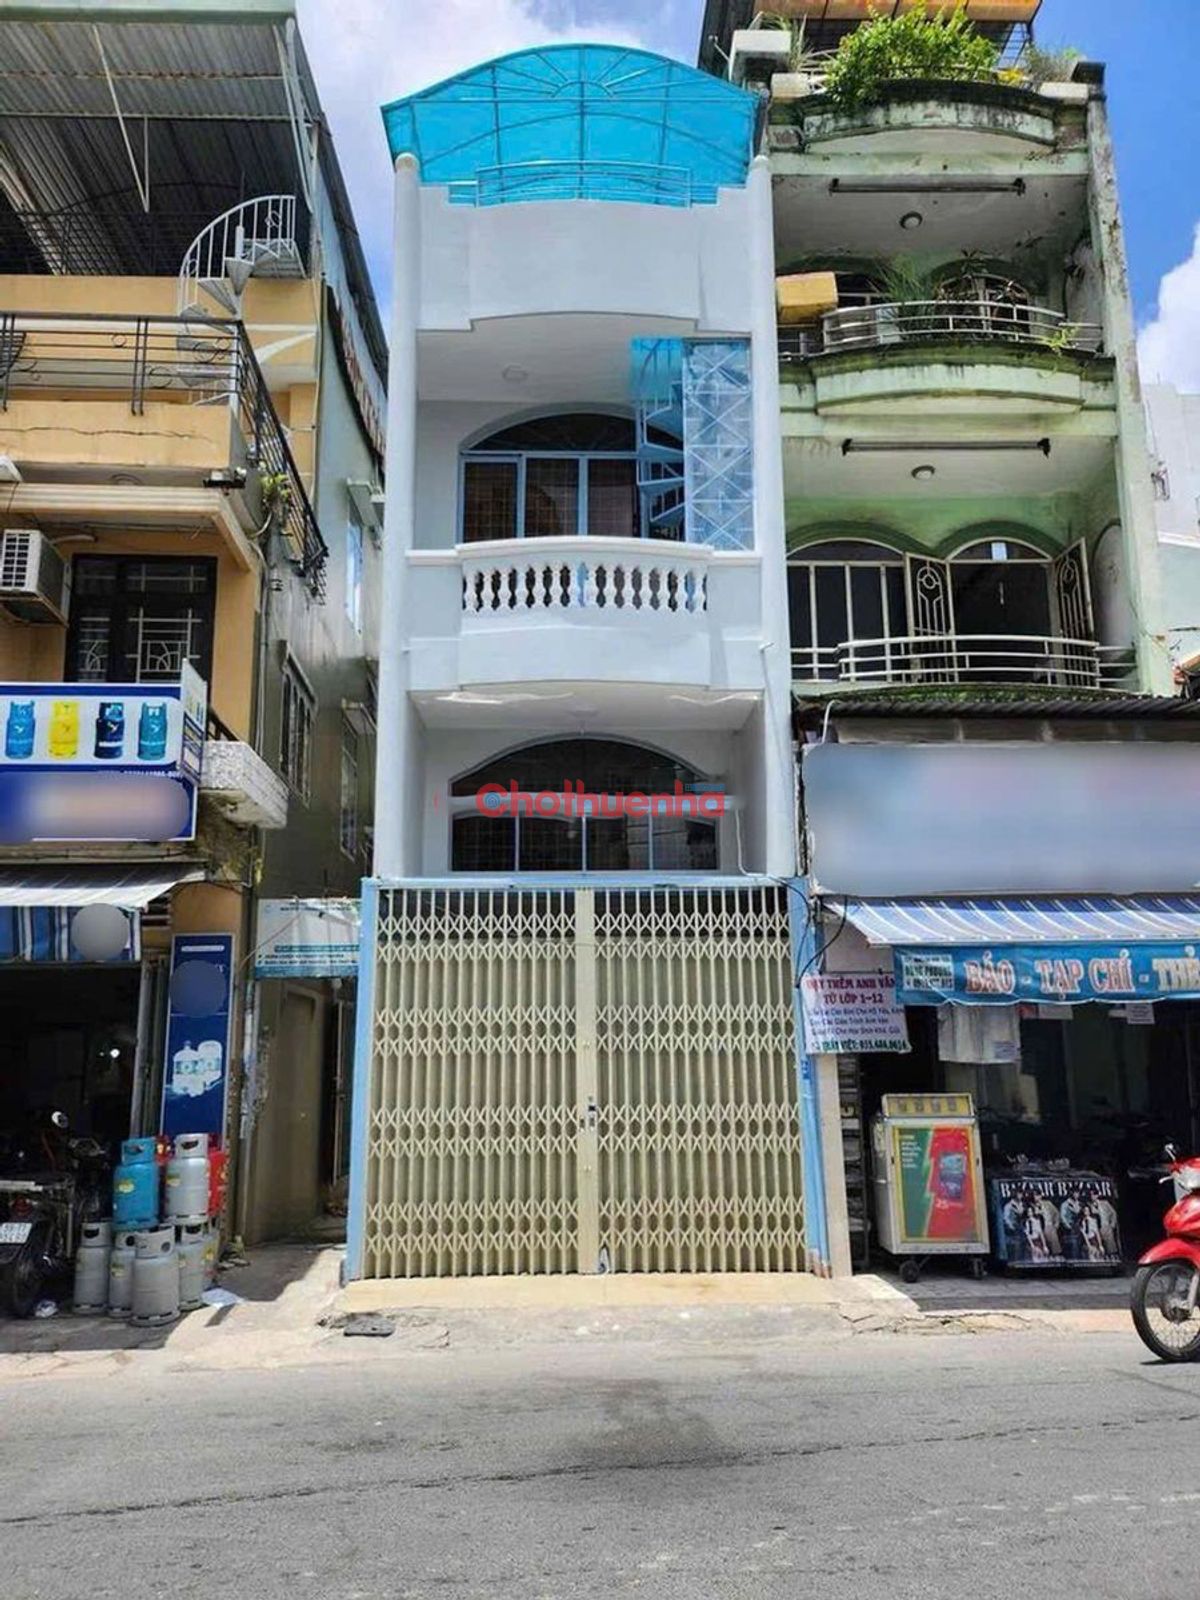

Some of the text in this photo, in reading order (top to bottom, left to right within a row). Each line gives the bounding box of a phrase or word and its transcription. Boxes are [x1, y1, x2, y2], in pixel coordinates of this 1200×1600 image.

[964, 951, 1015, 994] BÁO
[1034, 959, 1084, 1000] TẠP
[1088, 949, 1136, 993] CHÍ
[856, 978, 877, 989] ANH
[860, 993, 884, 1004] 1-12
